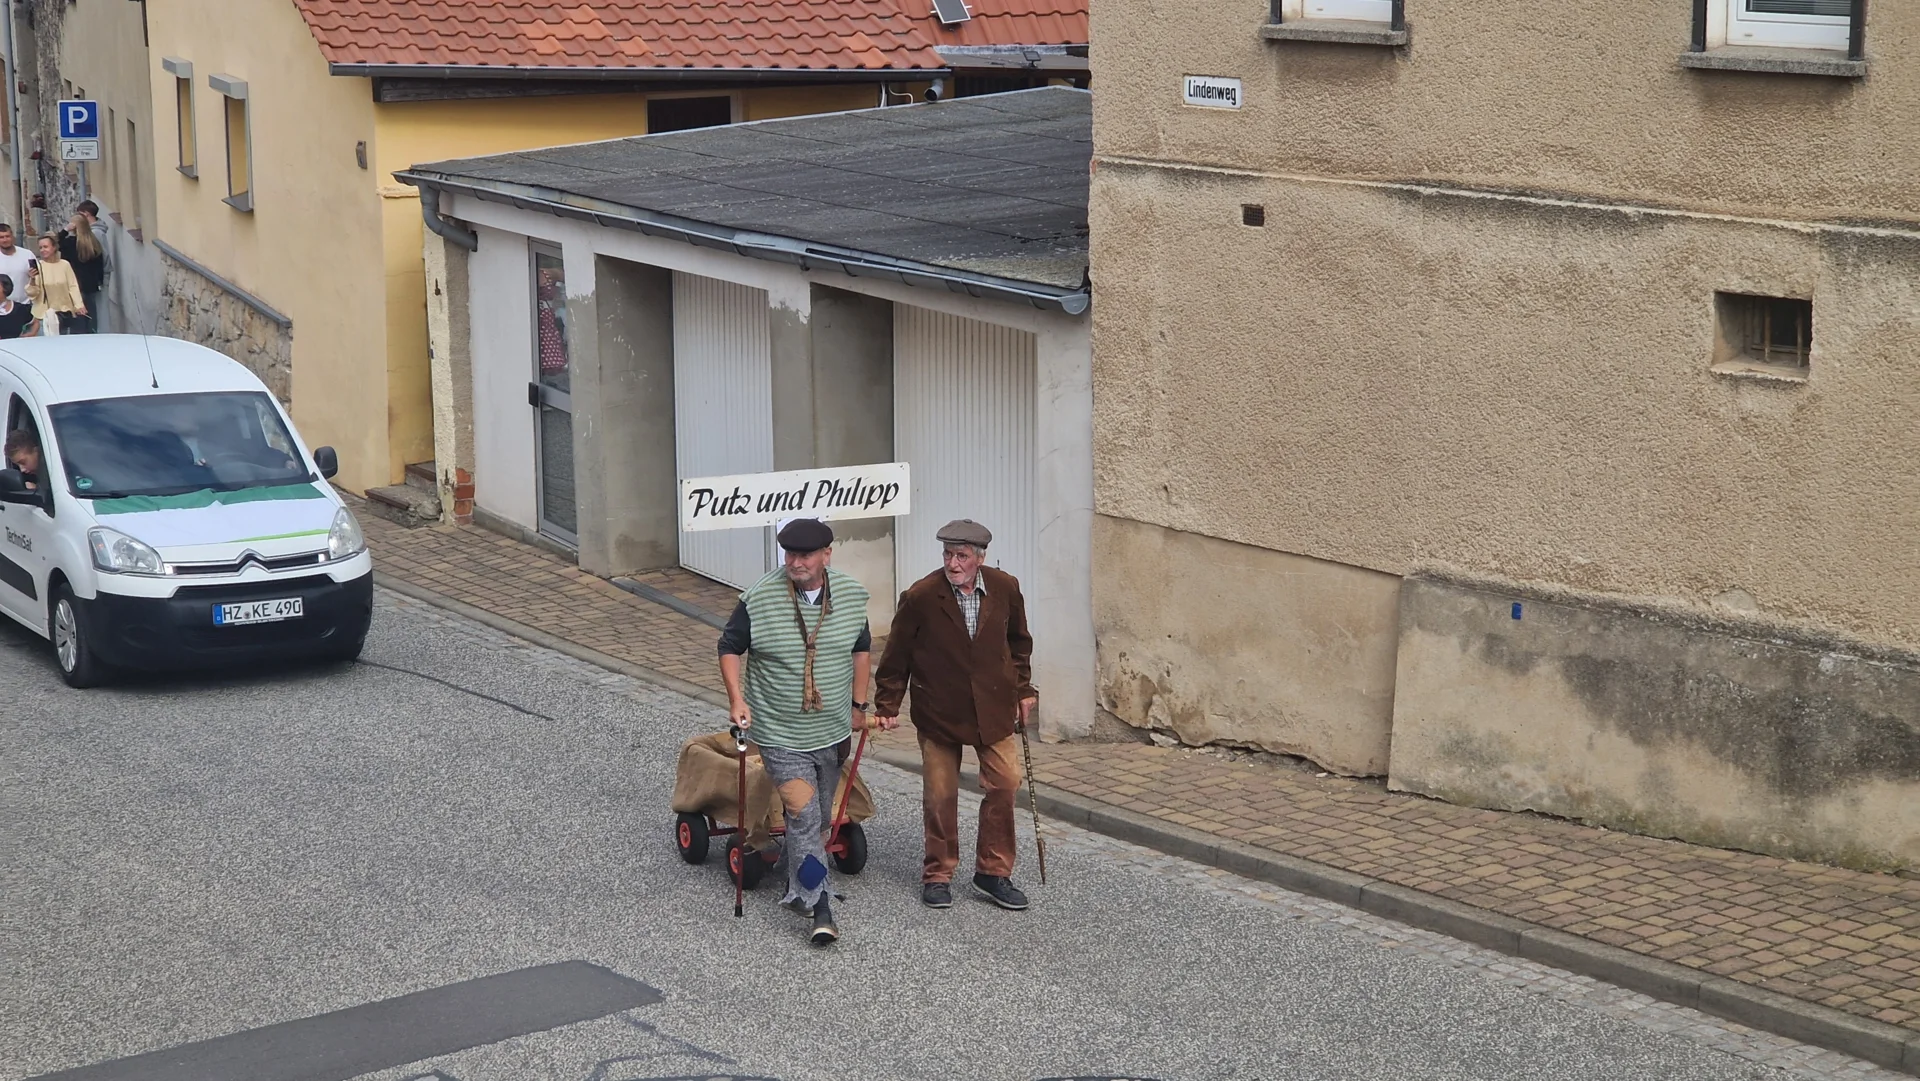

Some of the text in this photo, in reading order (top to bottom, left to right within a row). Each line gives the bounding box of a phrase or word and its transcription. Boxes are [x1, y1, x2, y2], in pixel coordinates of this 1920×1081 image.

[1188, 79, 1237, 106] Lindenweg
[67, 106, 89, 134] P
[688, 477, 900, 518] Putz und Philipp
[5, 526, 32, 552] TechniSat
[222, 606, 242, 621] HZ
[252, 603, 271, 619] KE
[275, 600, 301, 616] 490
